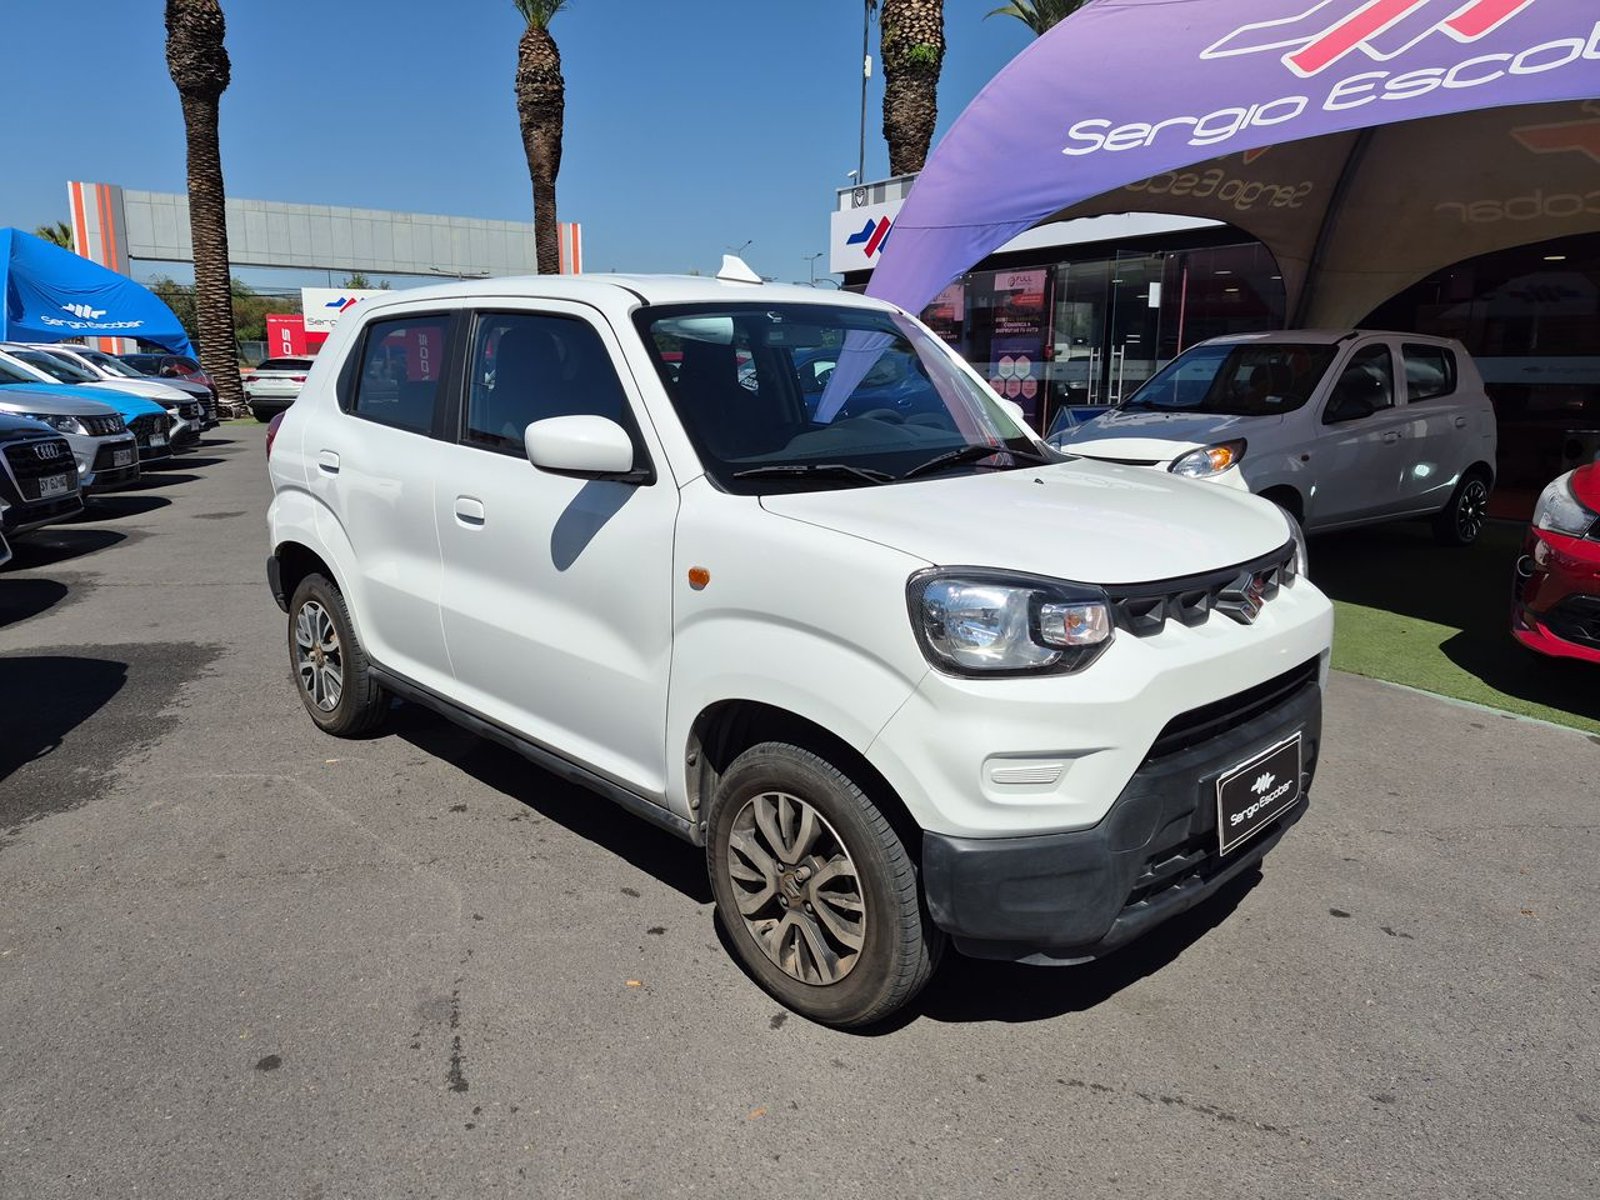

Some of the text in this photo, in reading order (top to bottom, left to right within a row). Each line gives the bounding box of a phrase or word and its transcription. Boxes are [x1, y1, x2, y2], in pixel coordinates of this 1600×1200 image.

[1062, 20, 1600, 156] Sergio Esco
[1259, 779, 1293, 808] Escobar
